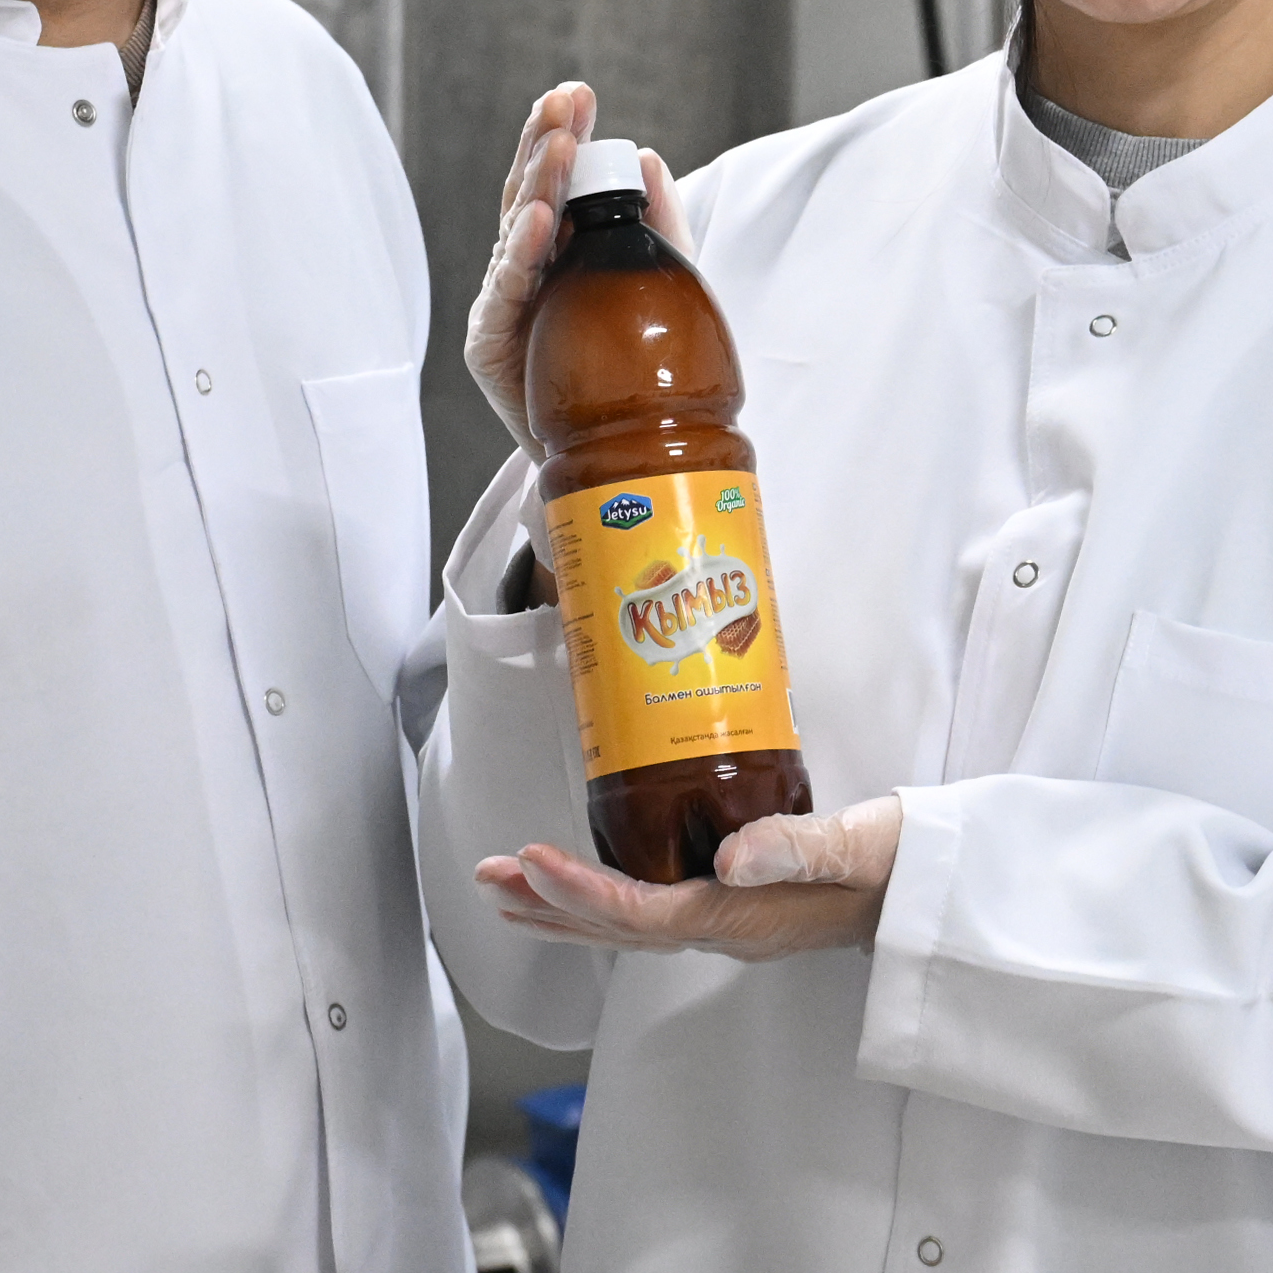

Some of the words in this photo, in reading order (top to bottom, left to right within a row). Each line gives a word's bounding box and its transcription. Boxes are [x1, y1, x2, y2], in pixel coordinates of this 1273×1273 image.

[721, 488, 741, 502] 100%
[605, 505, 648, 523] Jetysu
[716, 497, 745, 513] Organic
[644, 690, 692, 706] Балмен
[695, 683, 763, 699] ашытылған
[670, 731, 719, 745] Қазақстанда
[720, 727, 753, 738] жасалған
